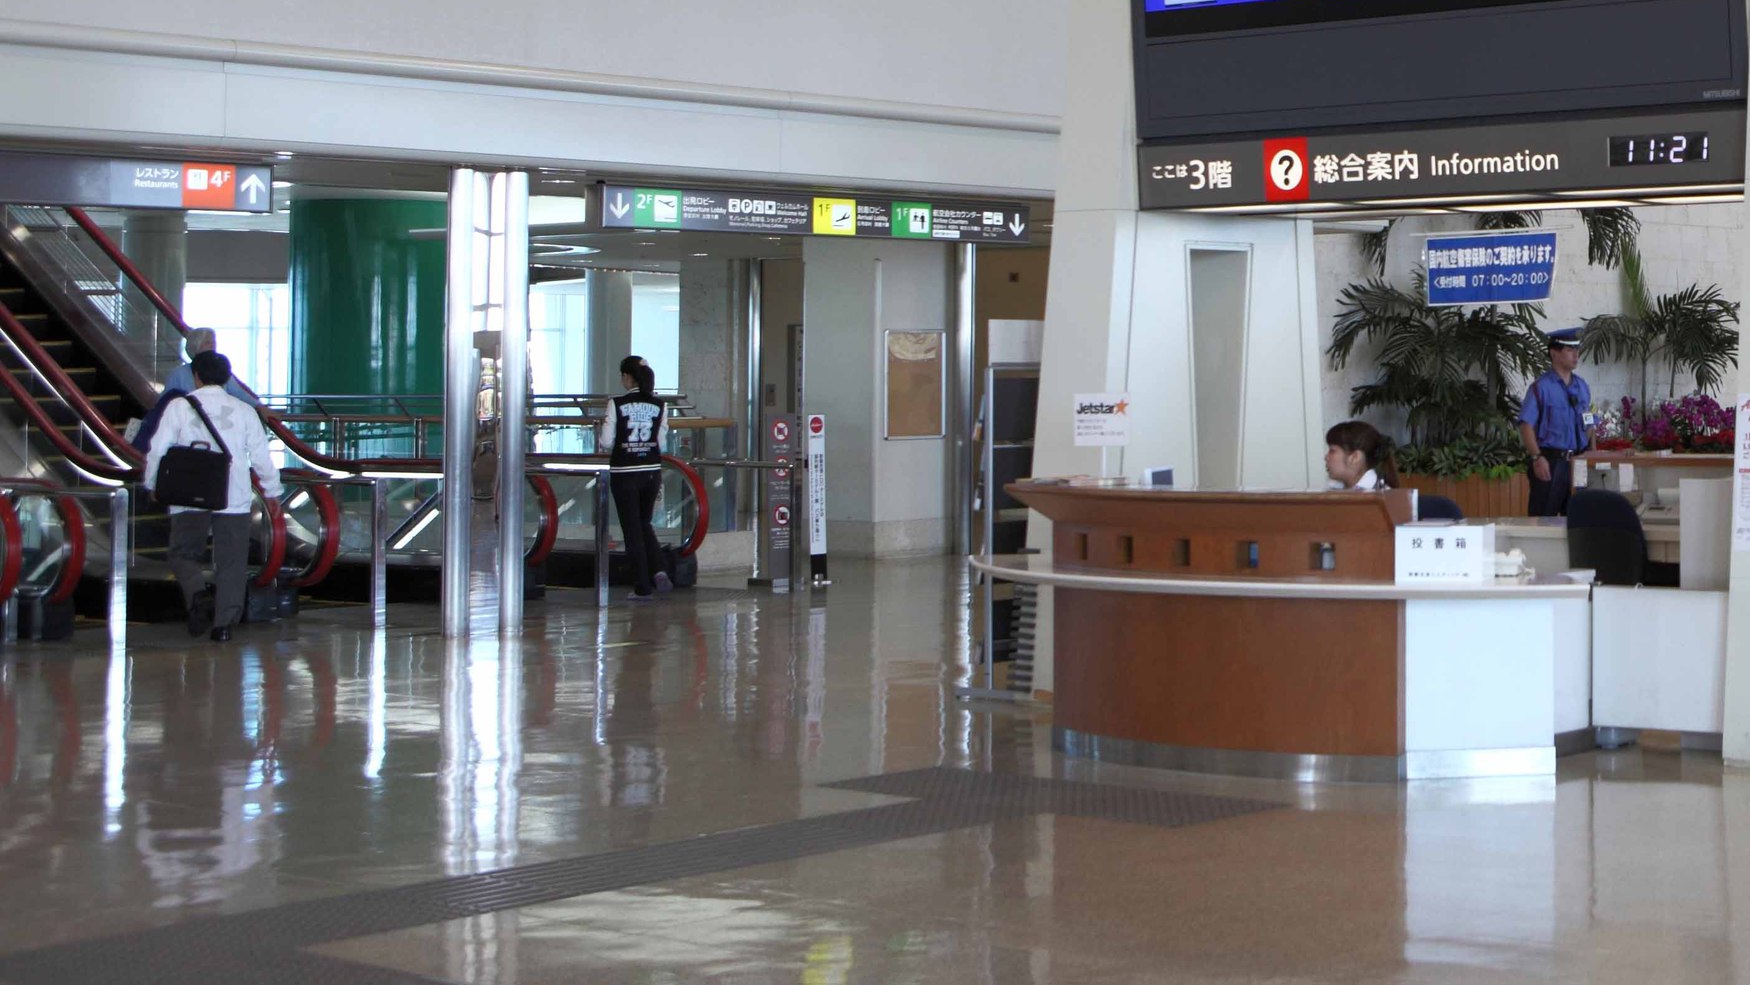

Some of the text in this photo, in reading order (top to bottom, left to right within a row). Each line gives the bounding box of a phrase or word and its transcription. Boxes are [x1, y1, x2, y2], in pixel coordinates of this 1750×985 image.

[1626, 135, 1709, 165] 11:21
[1313, 151, 1418, 185] 総合案内
[1430, 149, 1559, 177] Information
[135, 167, 179, 180] レストラン
[210, 170, 231, 188] 4F
[134, 179, 179, 189] Restaurants
[637, 193, 652, 209] 2F
[1076, 402, 1115, 415] Jetstar
